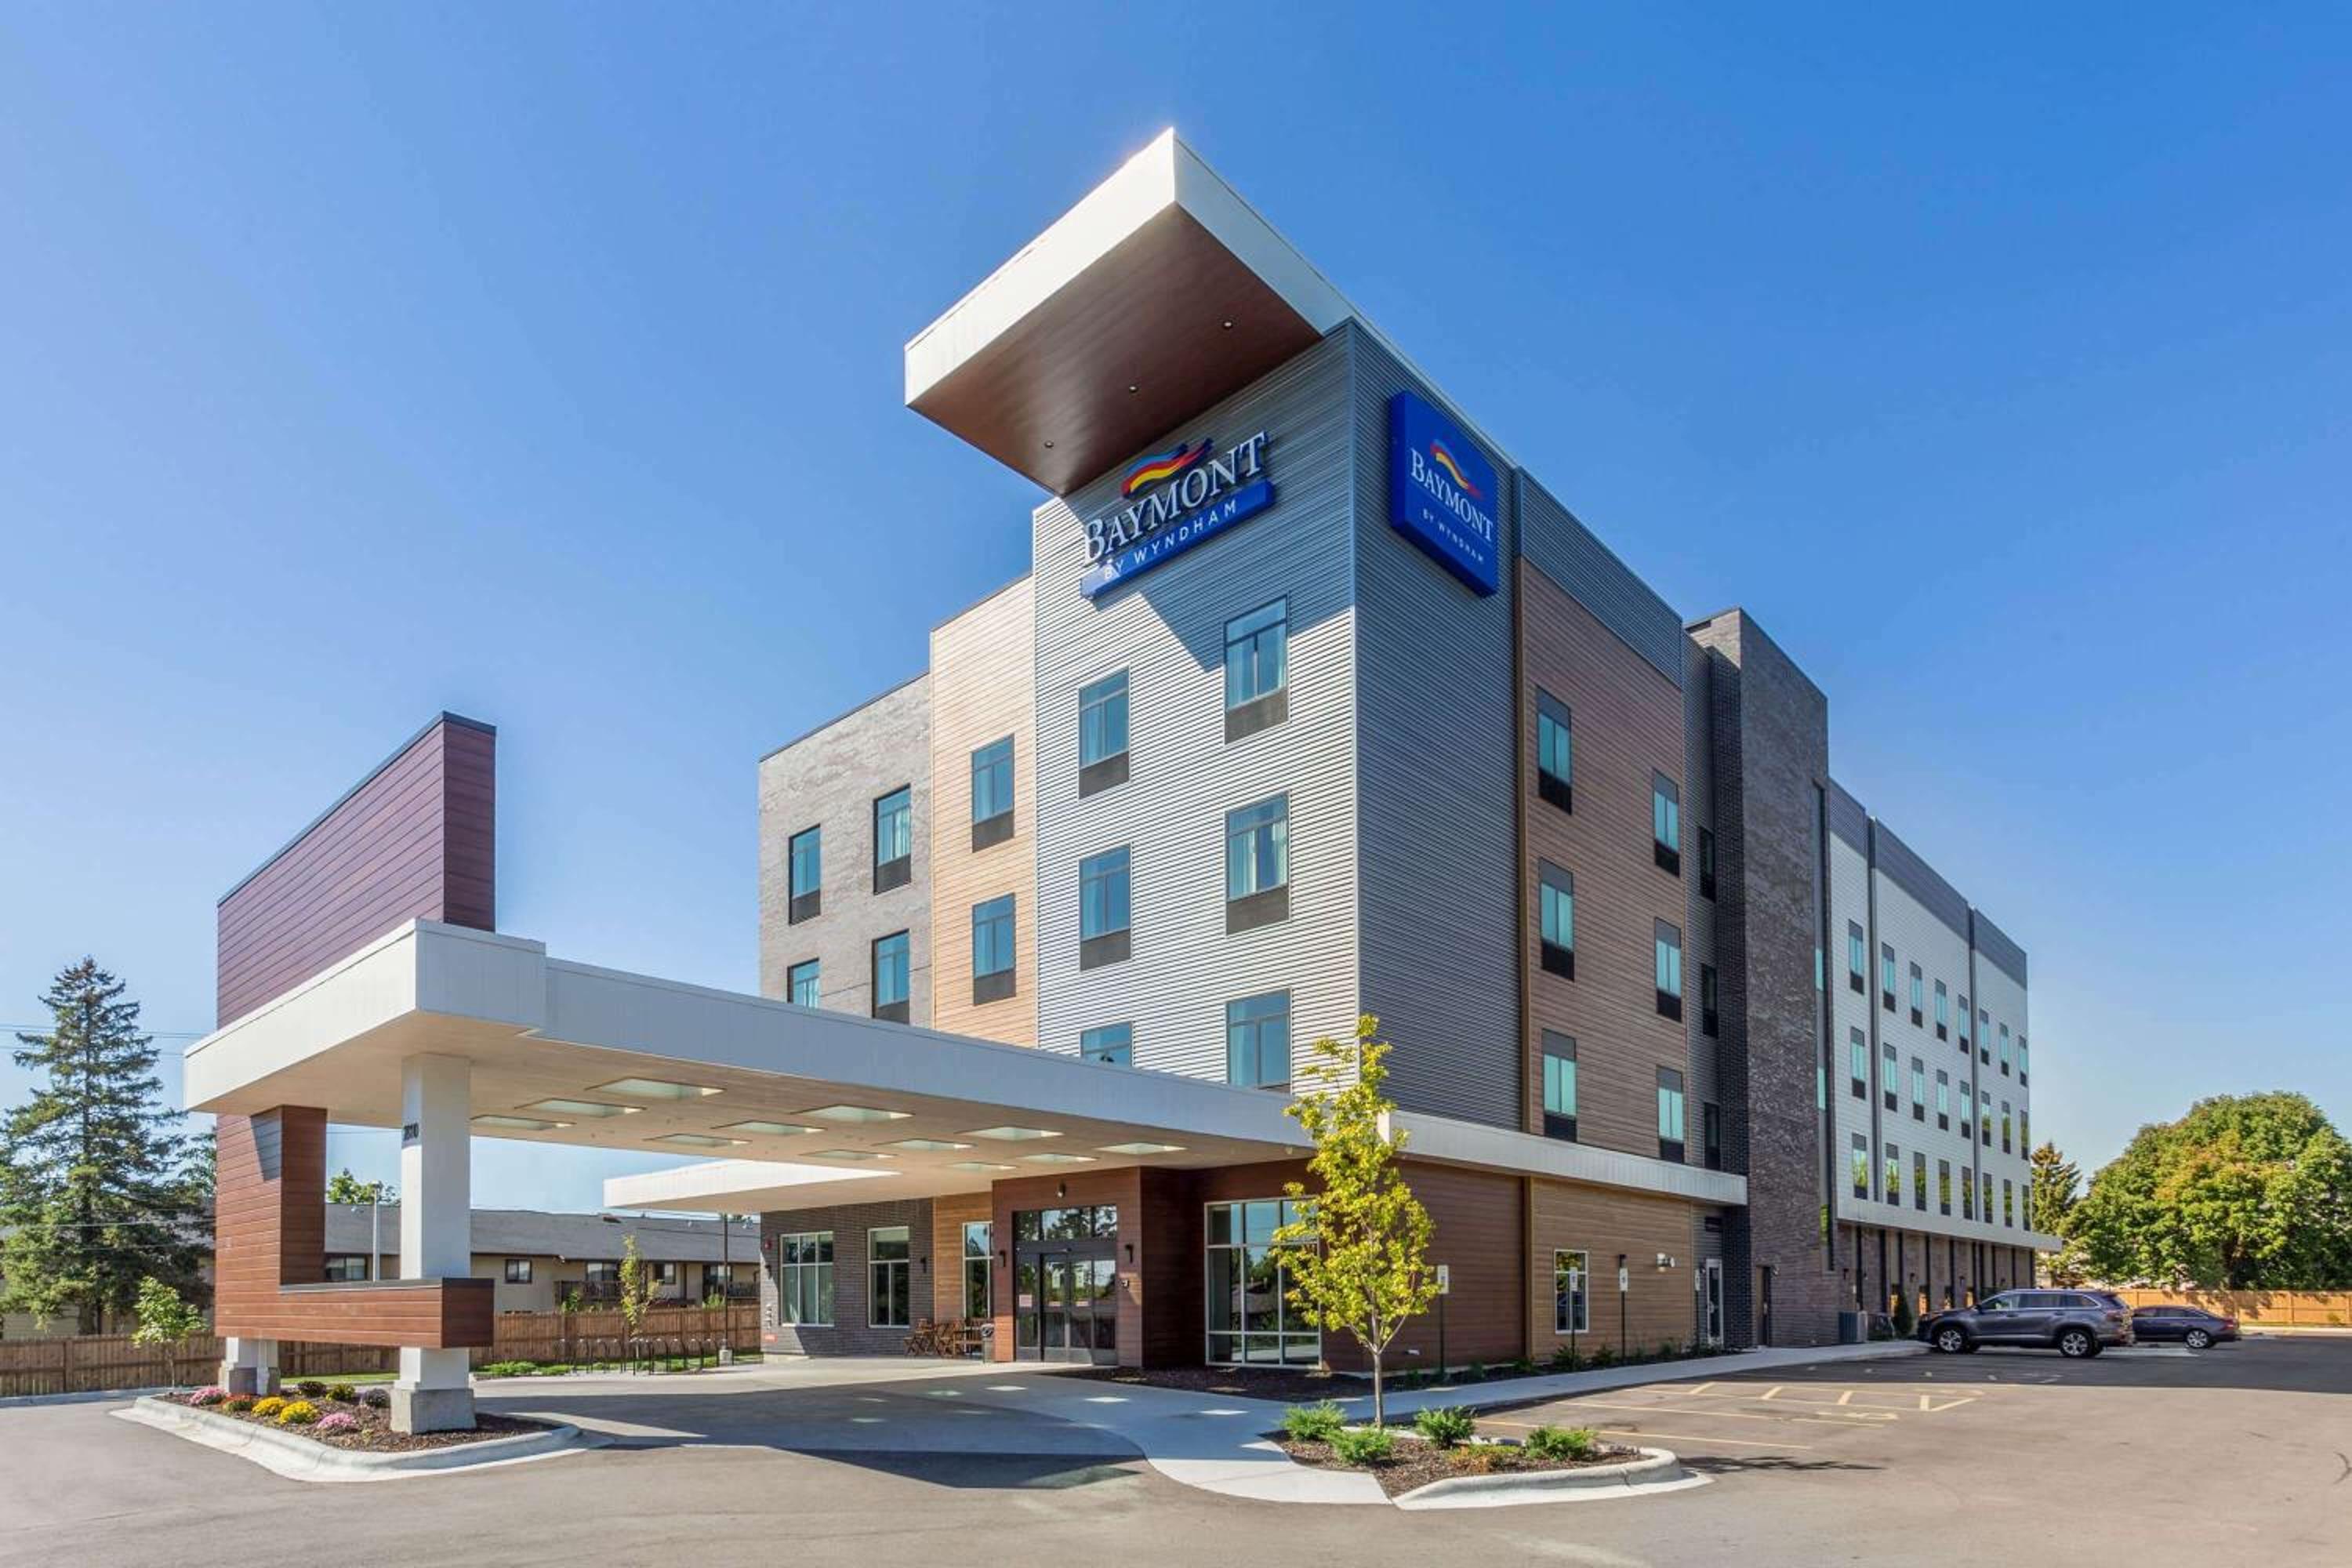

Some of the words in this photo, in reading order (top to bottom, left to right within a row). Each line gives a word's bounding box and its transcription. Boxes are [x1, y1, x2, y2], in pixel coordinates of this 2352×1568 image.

[1083, 431, 1266, 568] BAYMONT
[1104, 558, 1124, 579] BY
[1134, 499, 1236, 564] WYNDHAM
[1411, 448, 1493, 542] BAYMONT
